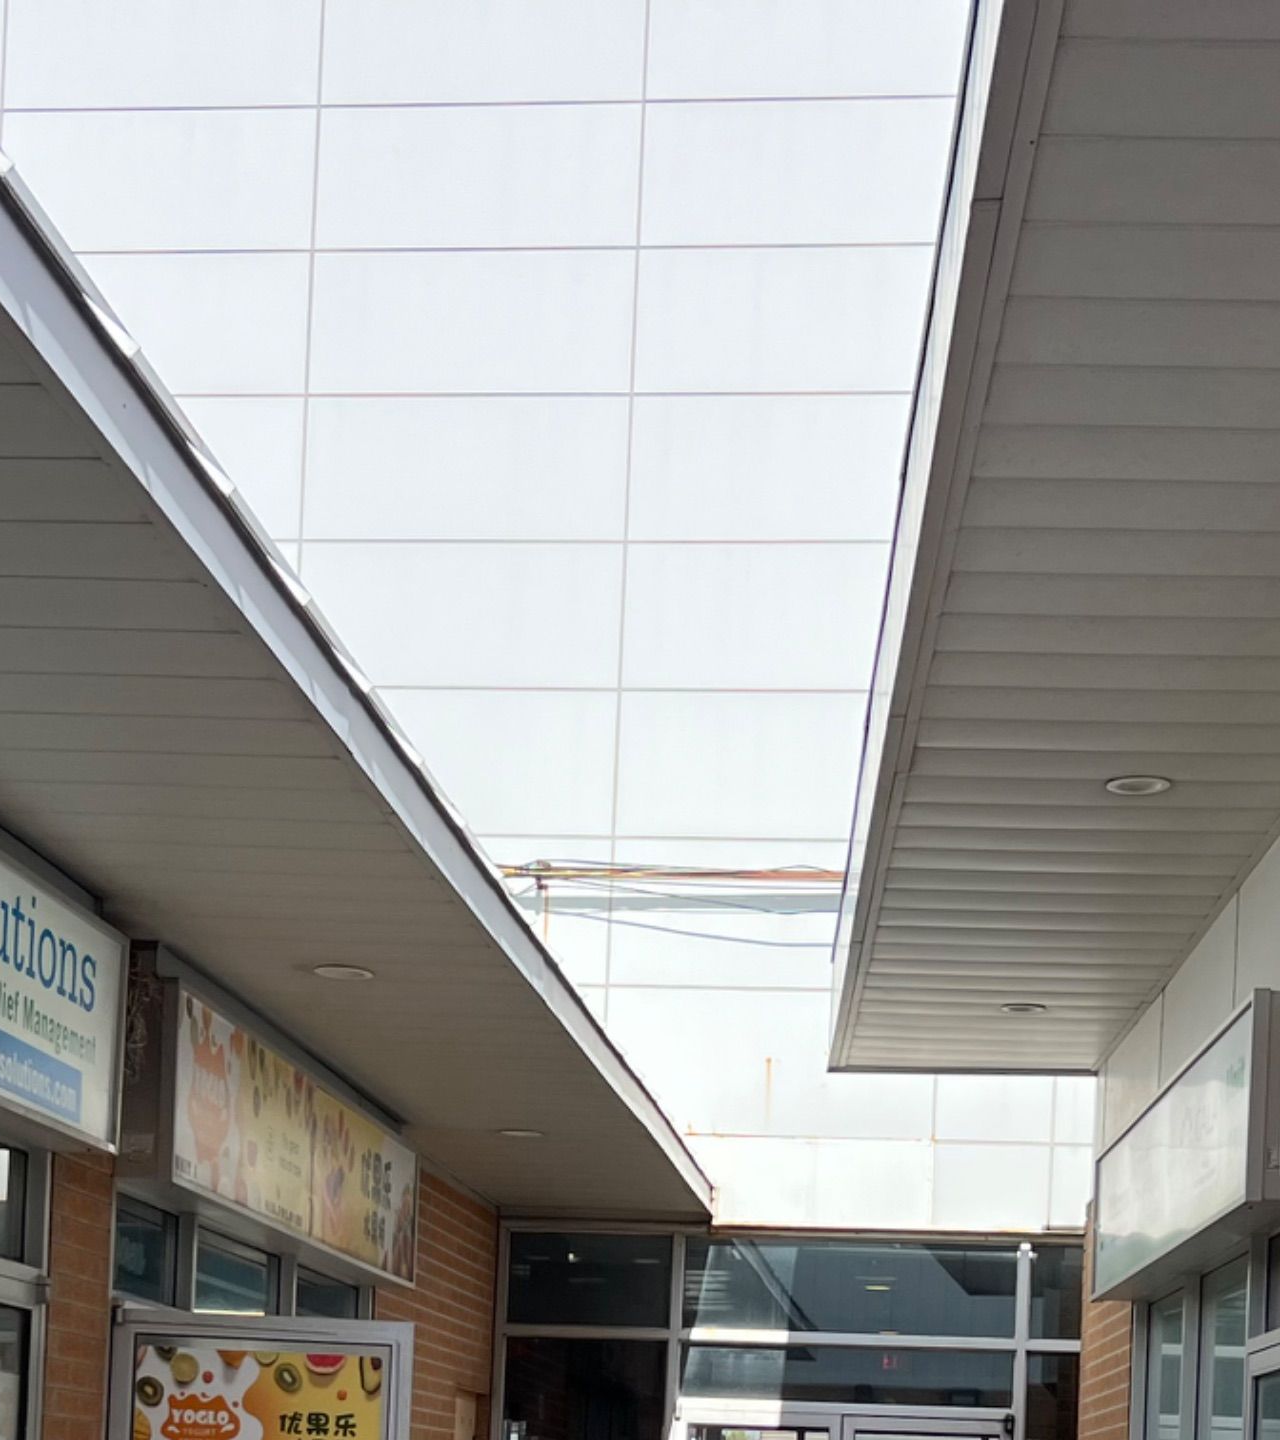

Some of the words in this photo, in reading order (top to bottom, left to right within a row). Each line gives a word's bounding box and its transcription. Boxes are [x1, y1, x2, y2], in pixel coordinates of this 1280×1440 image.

[22, 995, 96, 1066] Management
[279, 1411, 357, 1438] 优果乐
